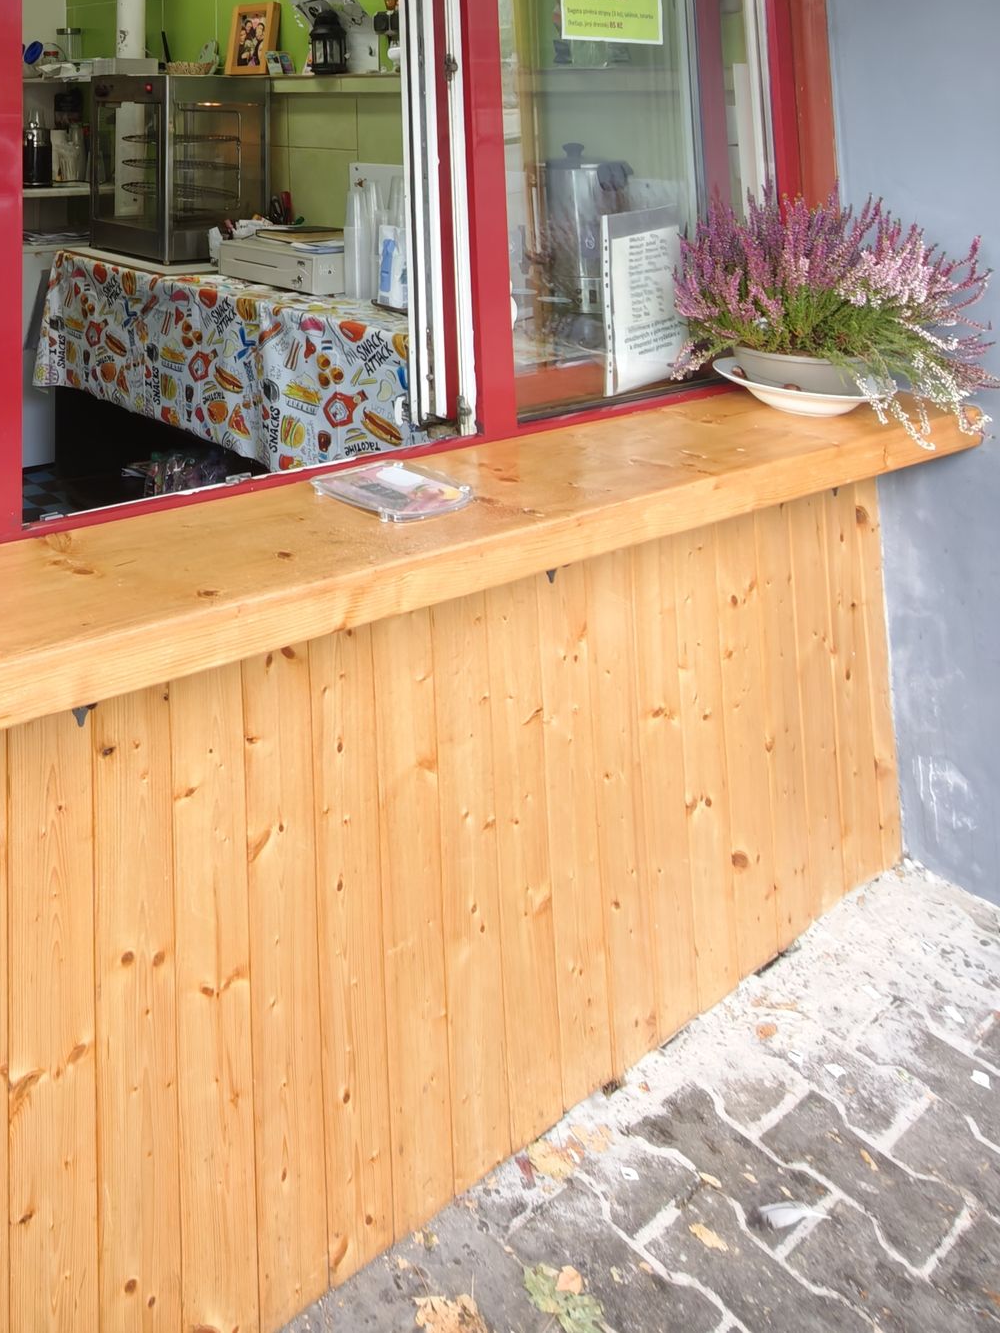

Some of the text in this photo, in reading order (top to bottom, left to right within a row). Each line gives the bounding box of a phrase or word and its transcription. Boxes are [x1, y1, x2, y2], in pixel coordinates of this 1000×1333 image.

[103, 275, 118, 298] SNACK
[107, 284, 123, 308] ATTACK
[210, 297, 231, 324] SNACK
[216, 309, 237, 337] ATTACK
[57, 334, 66, 368] SNACKS
[356, 330, 385, 362] SNACK
[364, 341, 394, 376] ATTACK
[152, 366, 160, 405] SNACKS
[270, 406, 280, 452] SNACKS
